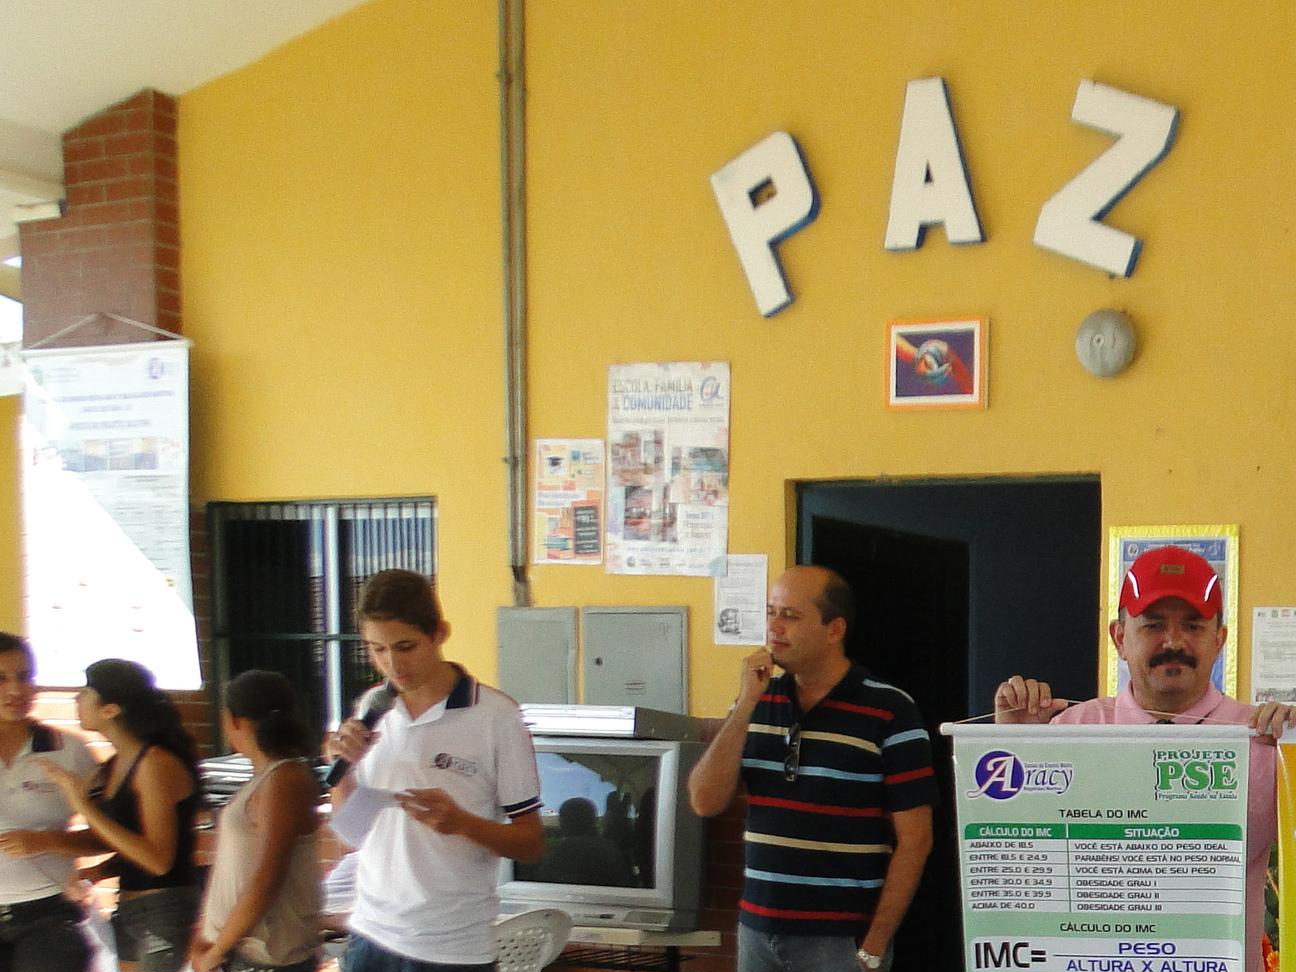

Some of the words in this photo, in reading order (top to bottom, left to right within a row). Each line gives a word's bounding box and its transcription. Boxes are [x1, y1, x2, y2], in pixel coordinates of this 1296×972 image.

[710, 76, 1181, 317] PAZ
[1156, 750, 1237, 760] PROJETO
[967, 754, 1073, 798] Aracy
[1156, 761, 1239, 790] PSE
[1059, 809, 1103, 818] TABELA
[1106, 809, 1123, 818] DO
[1127, 809, 1148, 818] IMC
[980, 826, 1019, 837] CÁLCULO
[1021, 828, 1034, 837] DO
[1036, 828, 1052, 837] IMC
[1125, 827, 1180, 838] SITUAÇÃO
[970, 841, 1002, 849] ABAIXO
[1004, 841, 1016, 849] DE
[1100, 842, 1122, 850] ESTÁ
[969, 853, 998, 861] ENTRE
[1019, 853, 1025, 861] E
[1027, 853, 1048, 861] 24.9
[1146, 854, 1167, 862] ESTÁ
[1101, 866, 1123, 874] ESTÁ
[1060, 921, 1111, 933] CÁLCULO
[1115, 923, 1131, 933] DO
[1135, 923, 1156, 933] IMC
[1118, 942, 1176, 955] PESO
[974, 941, 1047, 969] IMC=
[1066, 959, 1133, 972] ALTURA
[1142, 960, 1154, 972] X
